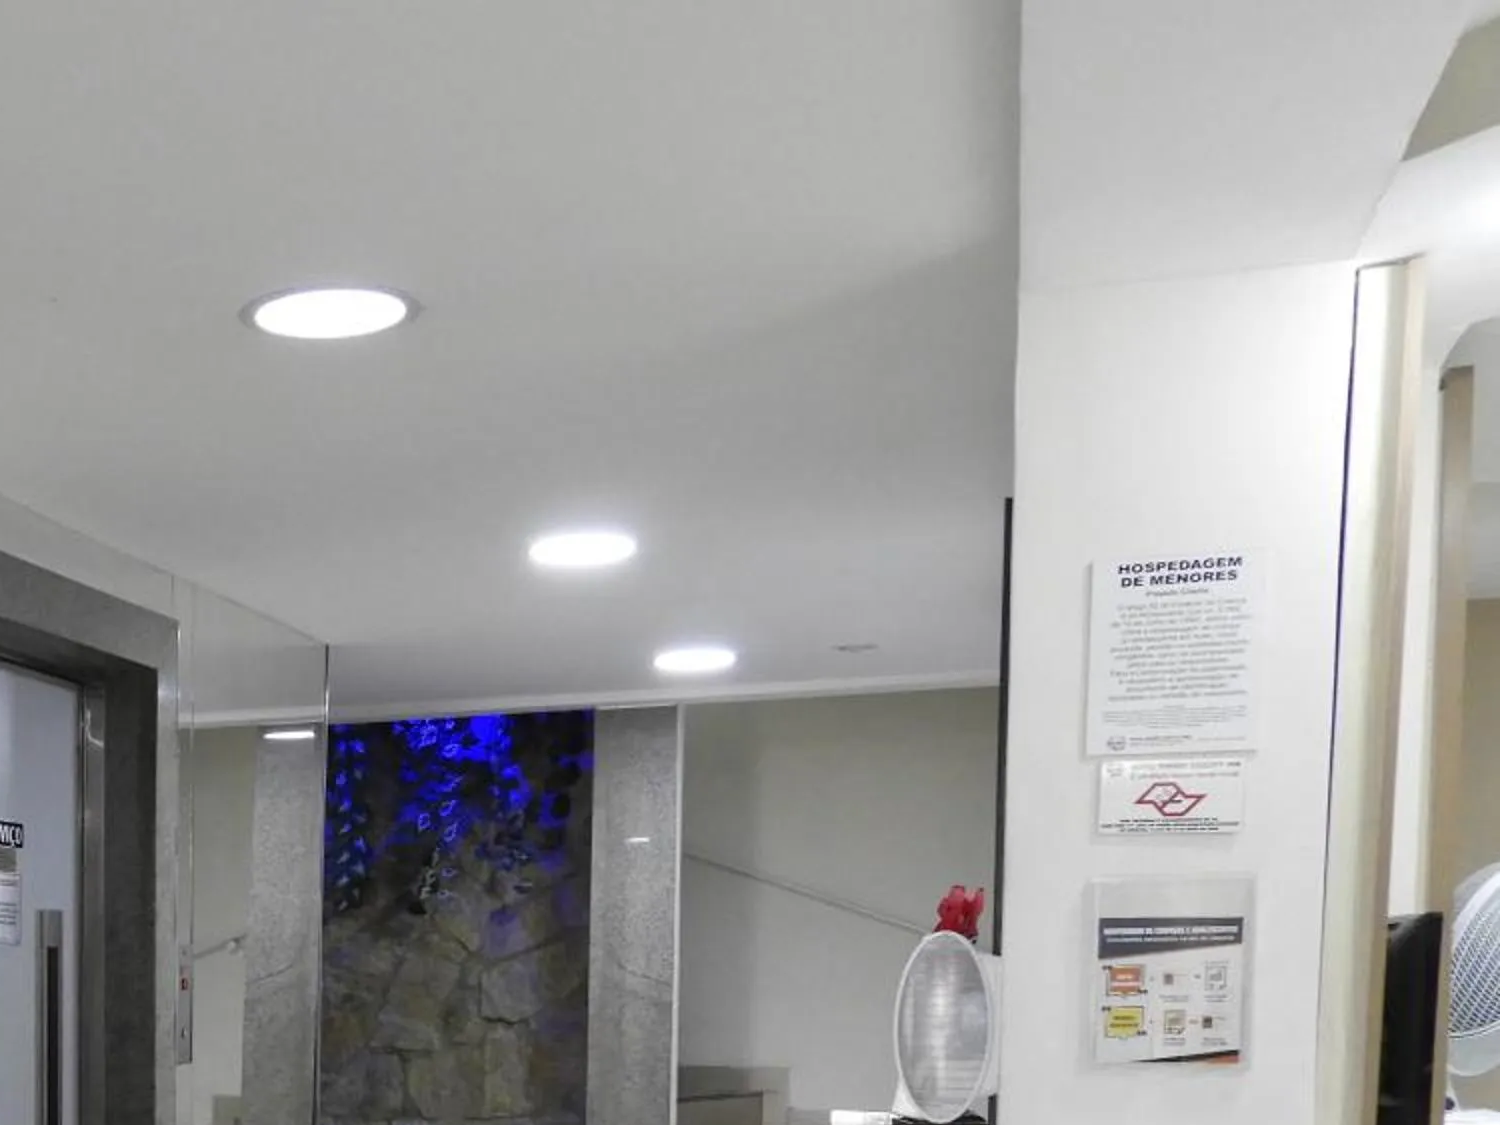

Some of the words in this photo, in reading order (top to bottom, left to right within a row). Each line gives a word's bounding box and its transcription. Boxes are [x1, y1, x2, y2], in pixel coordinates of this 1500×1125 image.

[1118, 556, 1243, 574] HOSPEDAGEM
[1121, 577, 1143, 587] DE
[1149, 570, 1238, 585] MENORES
